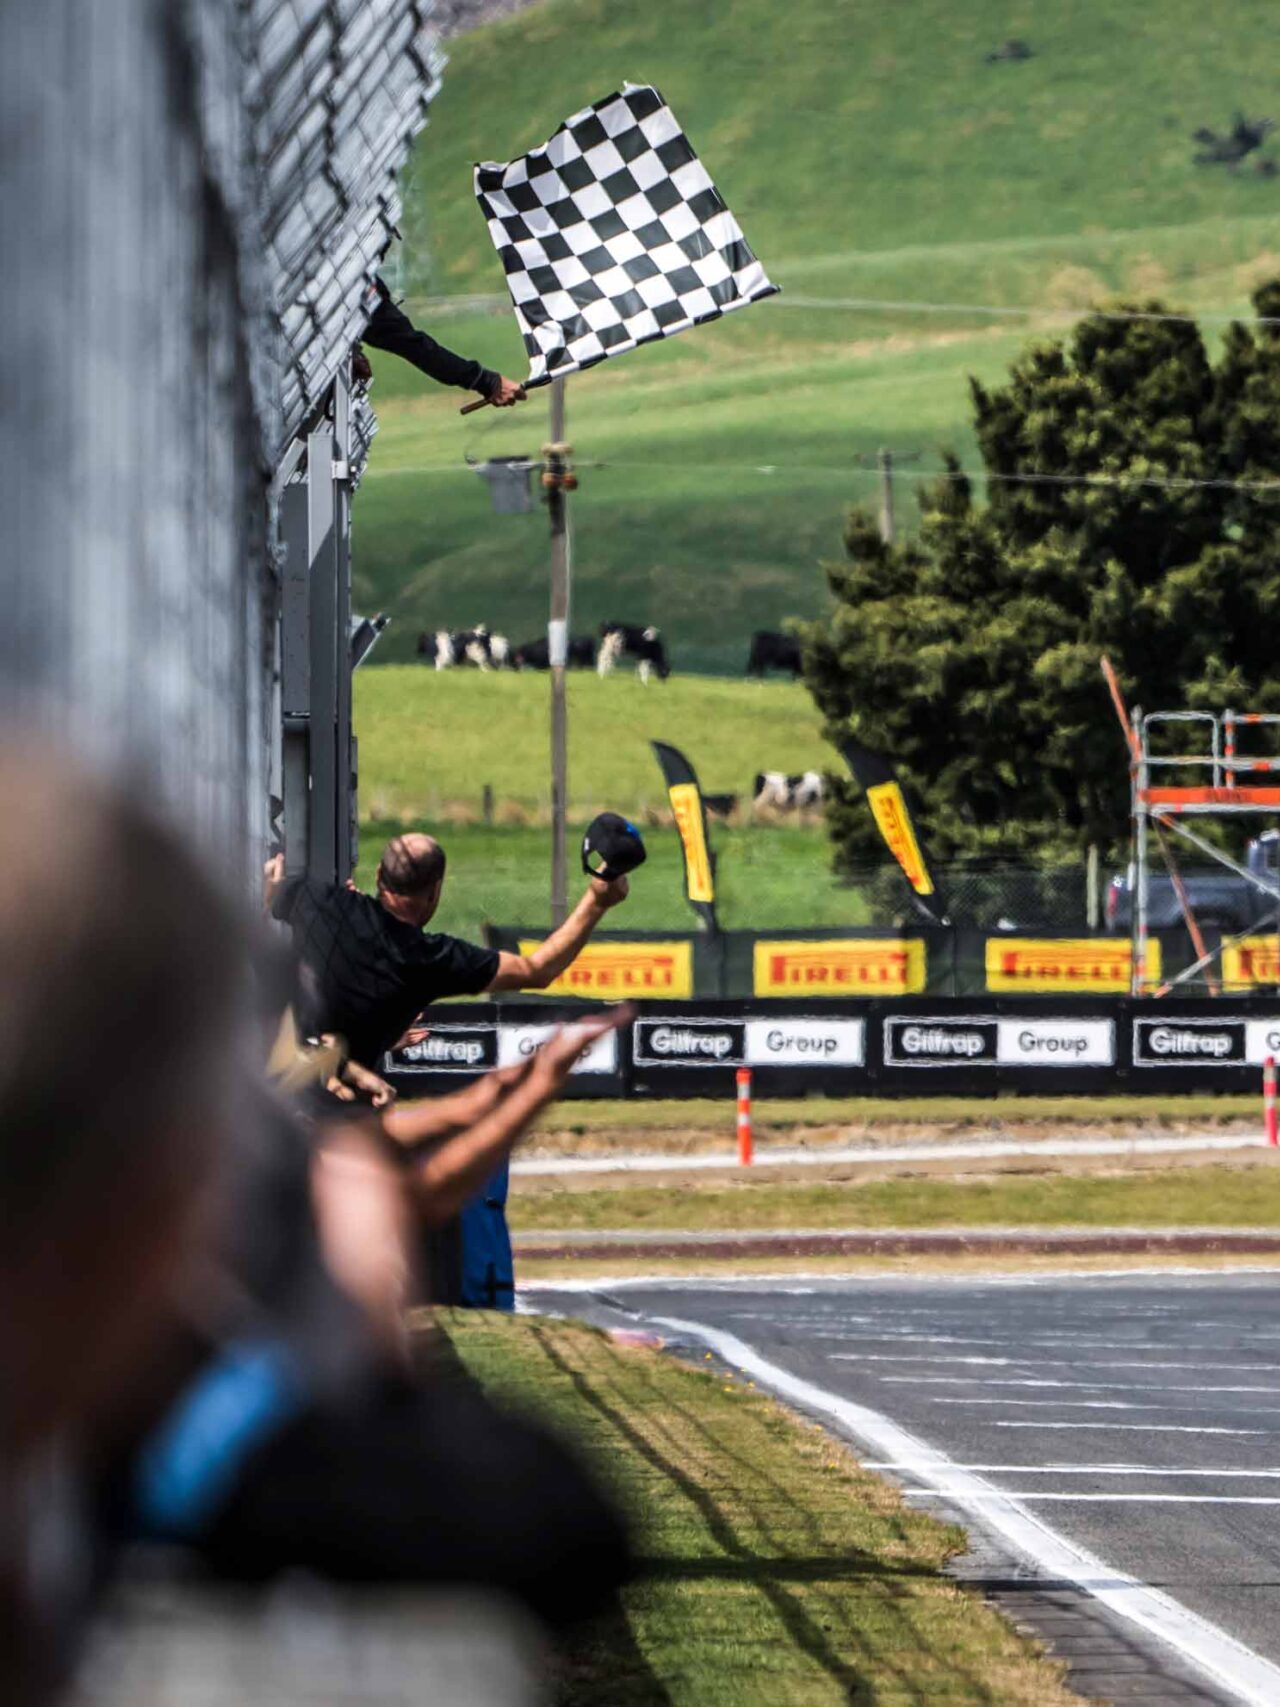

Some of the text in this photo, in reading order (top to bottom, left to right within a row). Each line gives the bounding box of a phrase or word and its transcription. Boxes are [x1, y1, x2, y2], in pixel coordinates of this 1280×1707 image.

[770, 951, 907, 984] PIRELLI
[1002, 951, 1132, 981] PIRELL
[651, 1027, 838, 1059] Giltrap Group
[901, 1027, 1089, 1057] Giltrap Group
[1149, 1027, 1233, 1057] Giltrap
